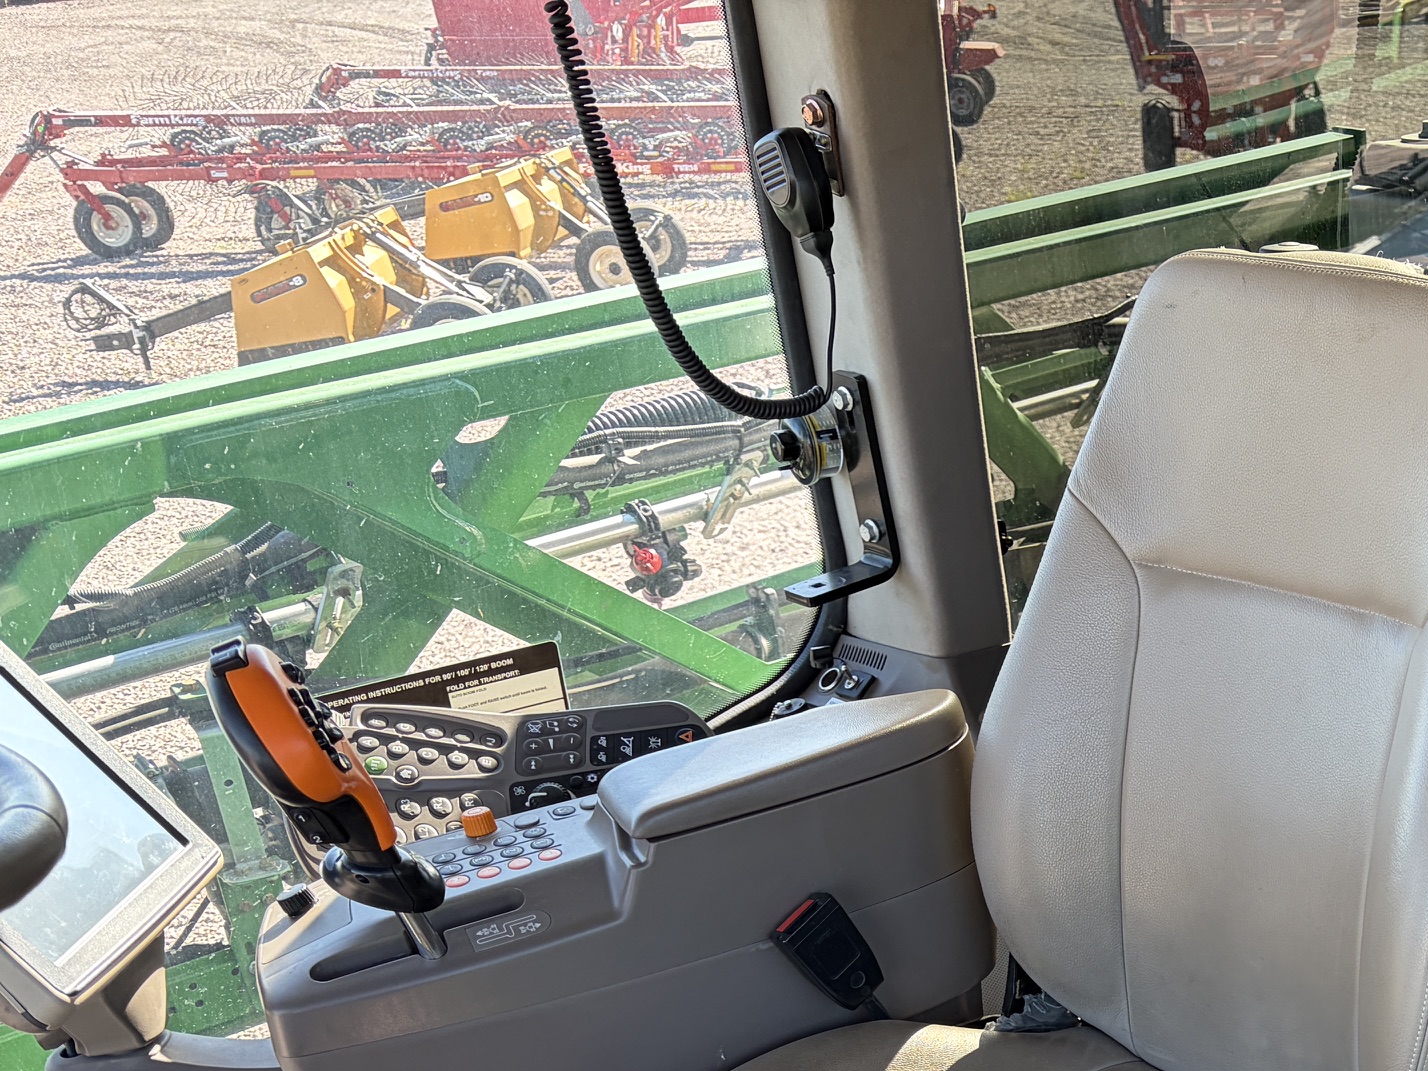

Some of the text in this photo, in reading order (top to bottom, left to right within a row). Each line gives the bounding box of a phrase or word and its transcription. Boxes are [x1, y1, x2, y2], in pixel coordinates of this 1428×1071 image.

[131, 114, 206, 126] Farm King
[620, 163, 652, 174] King
[368, 678, 424, 699] INSTRUCTIONS
[425, 674, 442, 686] FOR
[490, 658, 514, 669] BOOM
[446, 670, 520, 693] FOLD FOR TRANSPORT:
[401, 798, 411, 812] R3
[433, 798, 442, 810] R2
[466, 796, 475, 807] R1
[312, 835, 323, 844] 2
